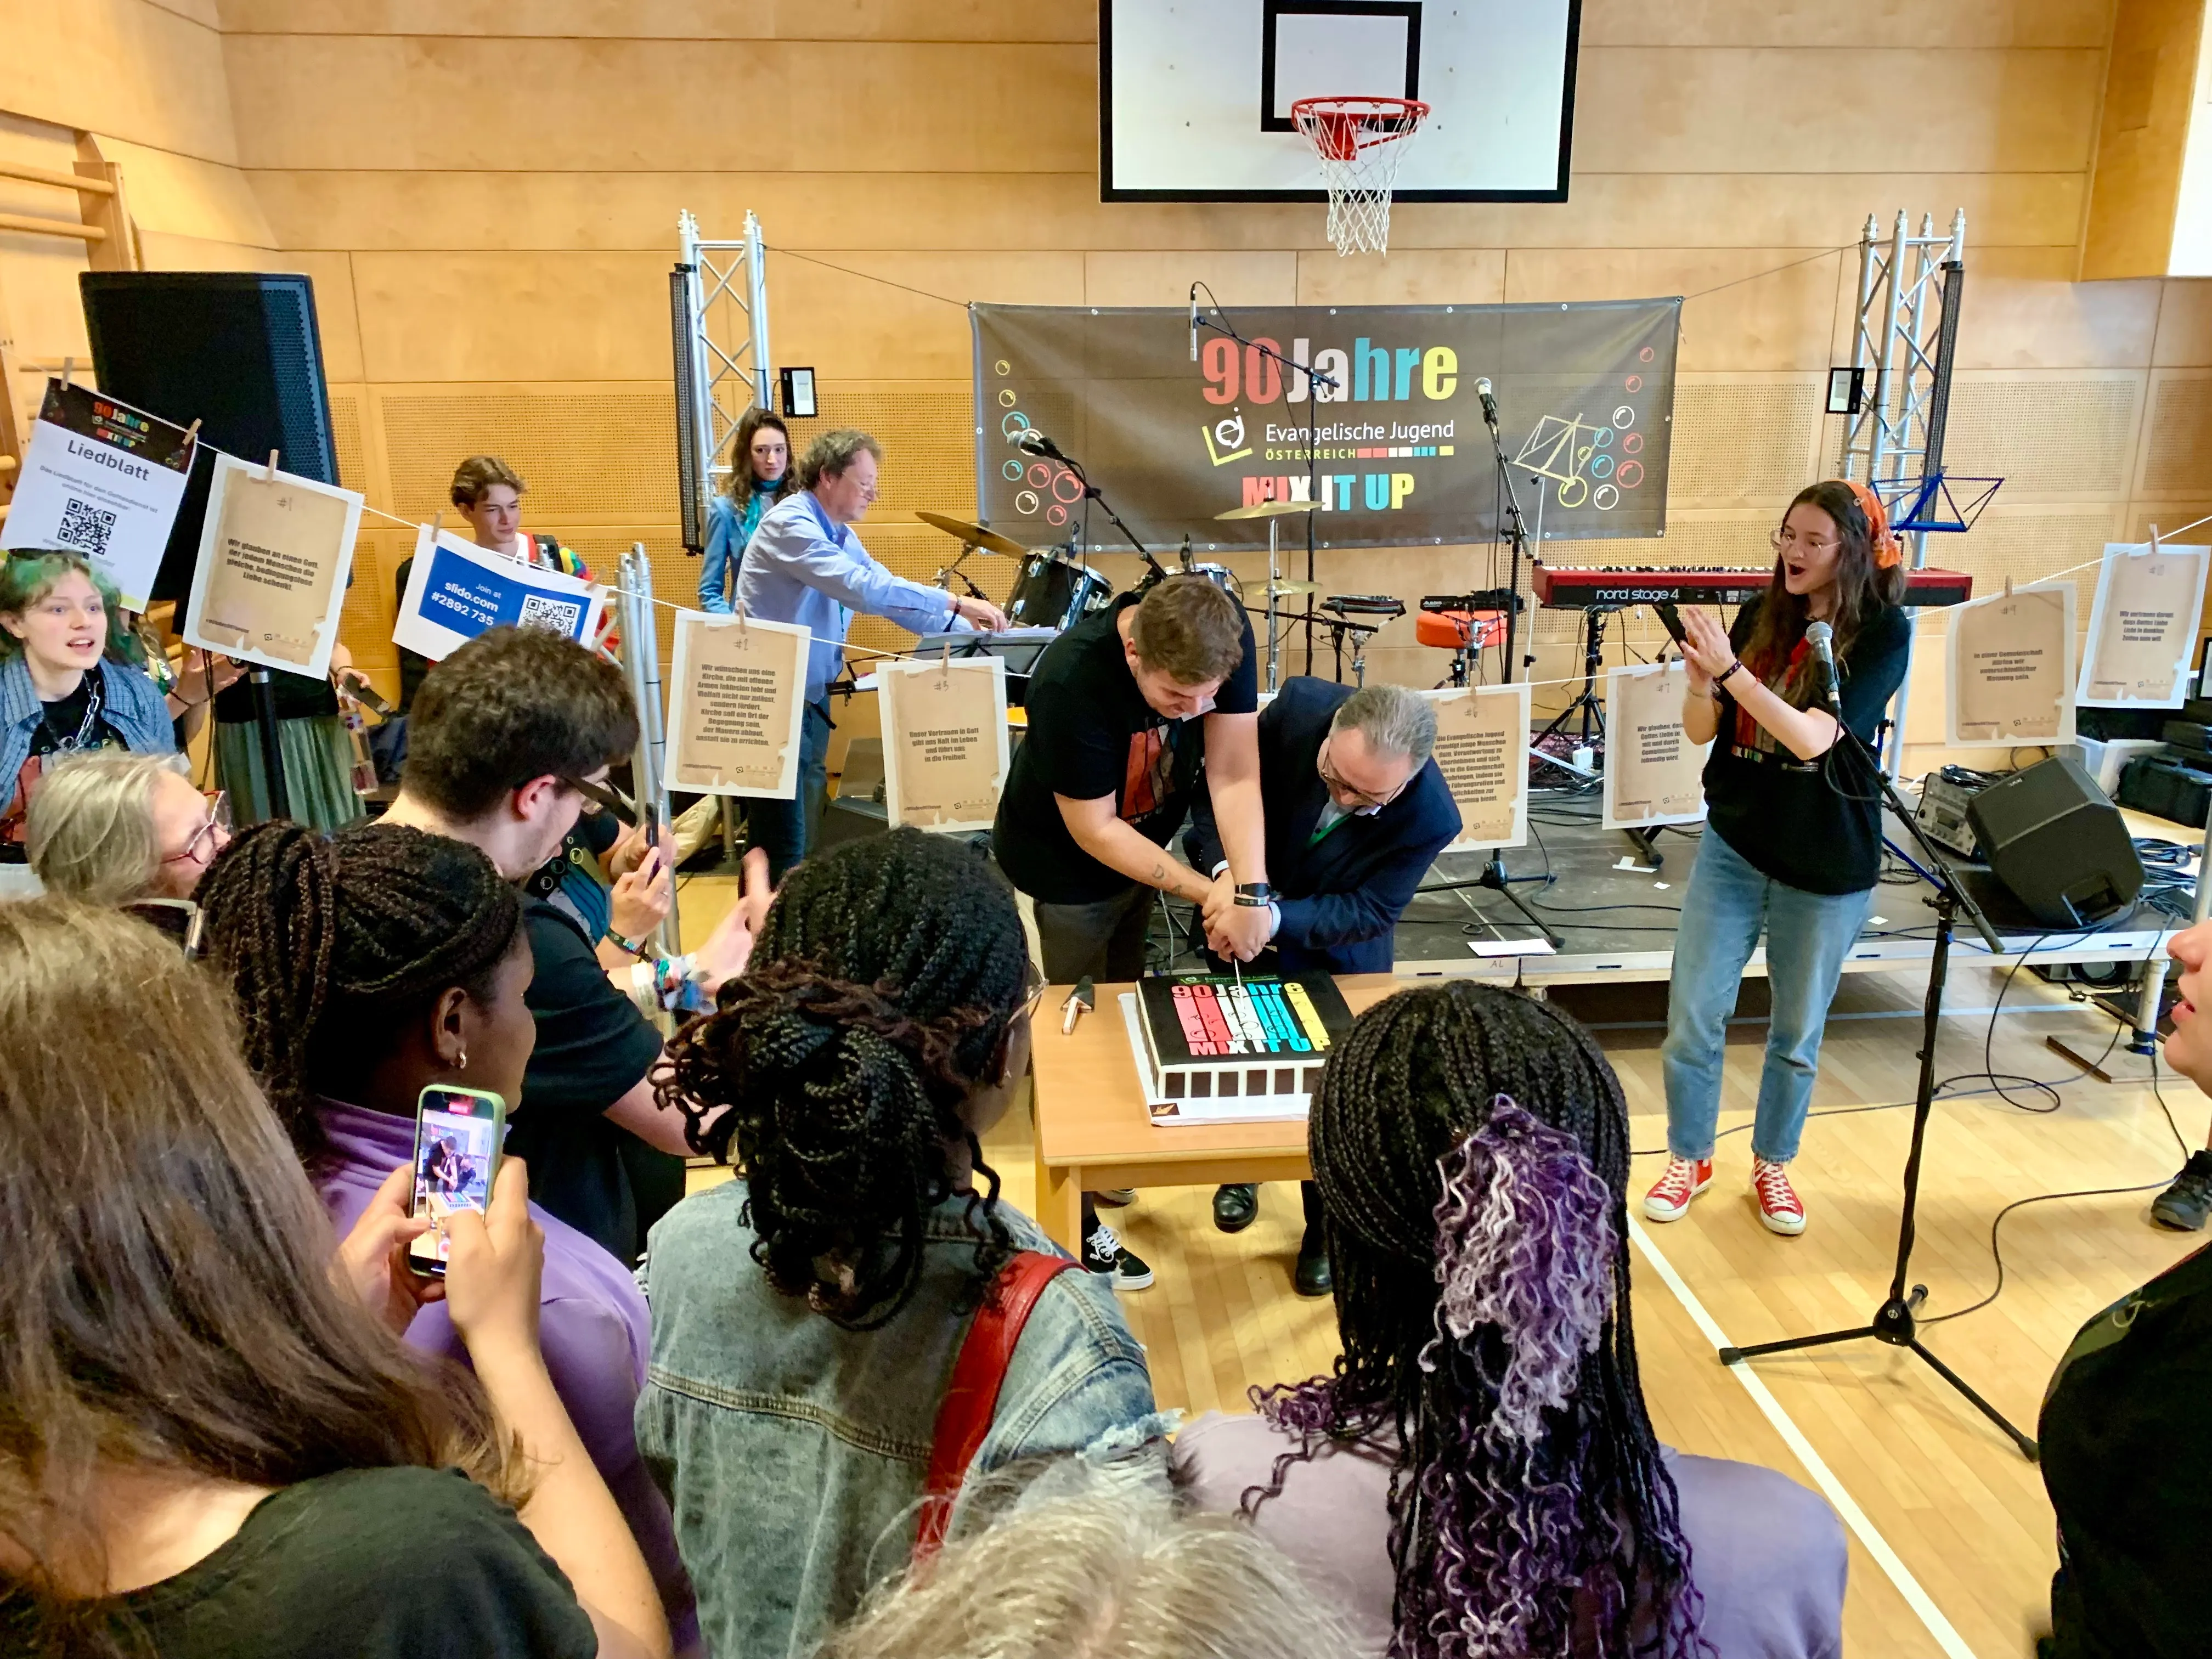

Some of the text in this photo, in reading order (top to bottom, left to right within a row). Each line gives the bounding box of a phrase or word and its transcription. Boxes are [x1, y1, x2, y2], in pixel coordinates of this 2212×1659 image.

[1203, 337, 1458, 404] 90Jahre
[1266, 420, 1454, 445] Evangelische Jugend
[67, 440, 149, 481] Liedblatt
[1265, 448, 1356, 460] ÖSTERREICH
[1242, 473, 1414, 511] MIX IT UP
[242, 552, 264, 563] jedem
[266, 558, 302, 574] Menschen
[243, 572, 262, 583] Liebe
[476, 583, 491, 595] Join
[1596, 589, 1679, 602] nord stage 4
[445, 583, 498, 612] slido.com
[431, 591, 494, 625] #2892 735
[722, 692, 738, 700] nicht
[708, 718, 744, 727] Begegnung
[715, 727, 740, 735] Mauern
[1447, 732, 1483, 741] Evangelische
[1171, 983, 1305, 998] 90Jahre
[1188, 1041, 1249, 1056] MIX
[1252, 1039, 1281, 1053] IT
